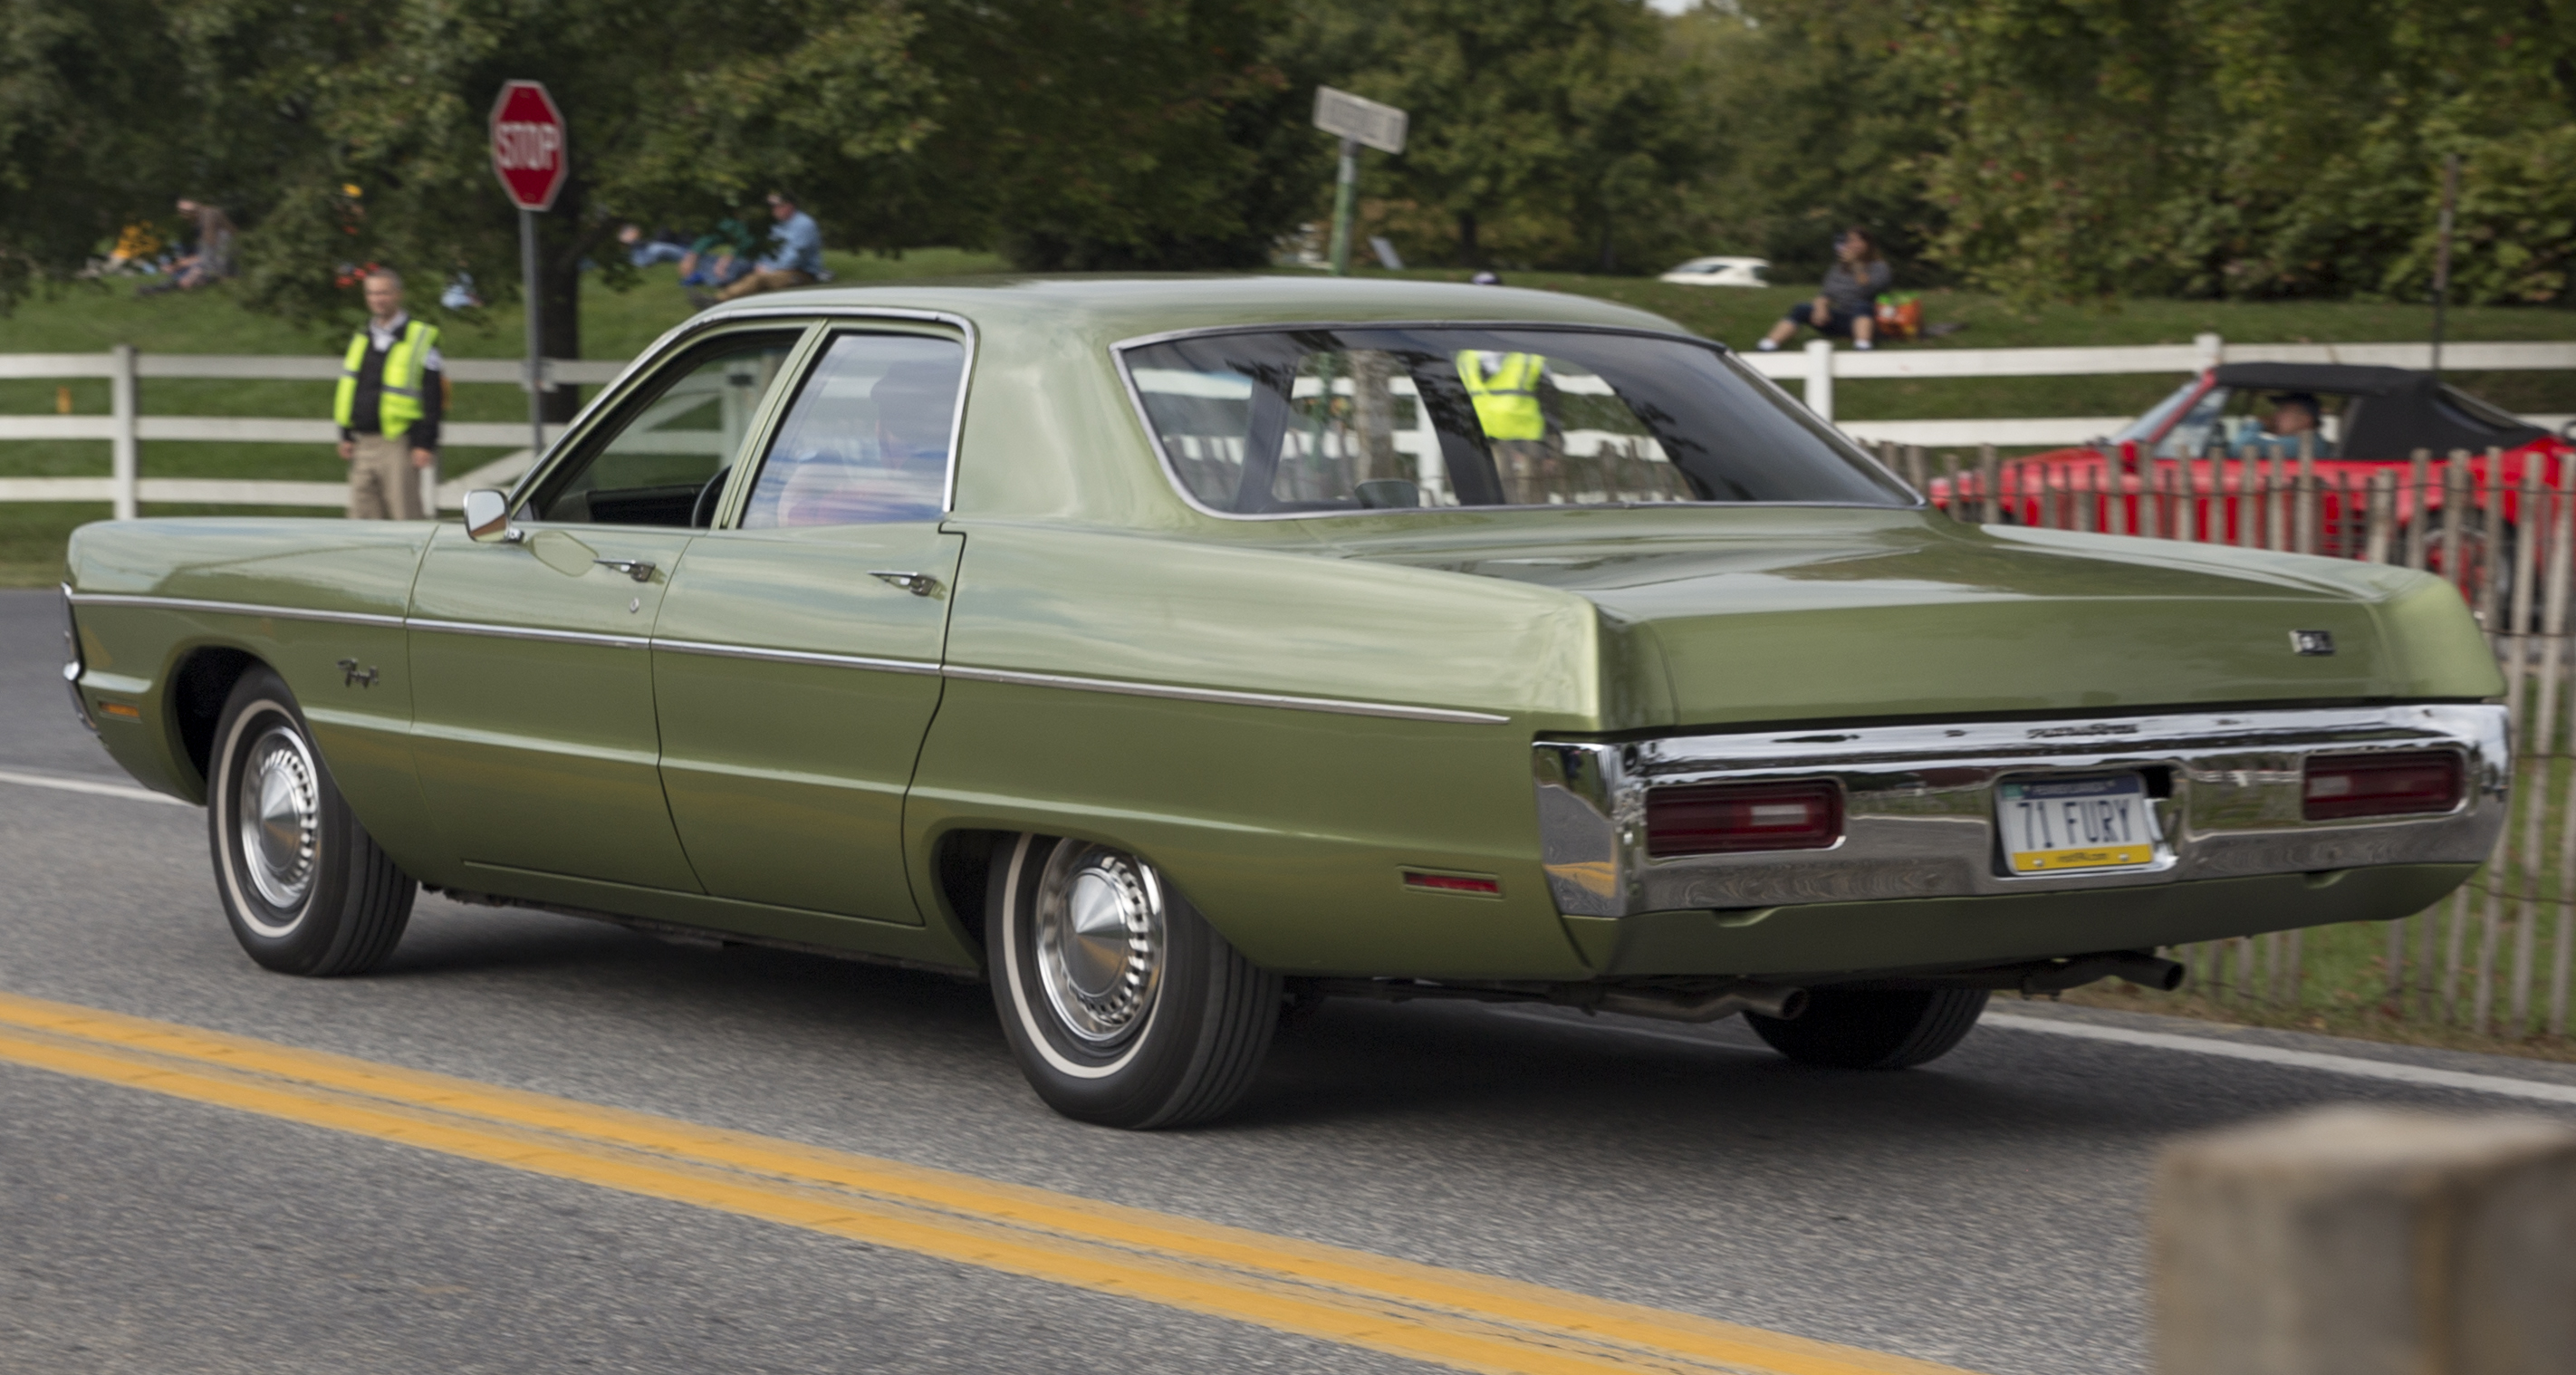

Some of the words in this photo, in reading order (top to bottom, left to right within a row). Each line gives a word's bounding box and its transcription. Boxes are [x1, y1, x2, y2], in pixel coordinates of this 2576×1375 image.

[497, 123, 561, 170] STOP
[2017, 801, 2053, 850] 71
[2062, 798, 2132, 844] FURY
